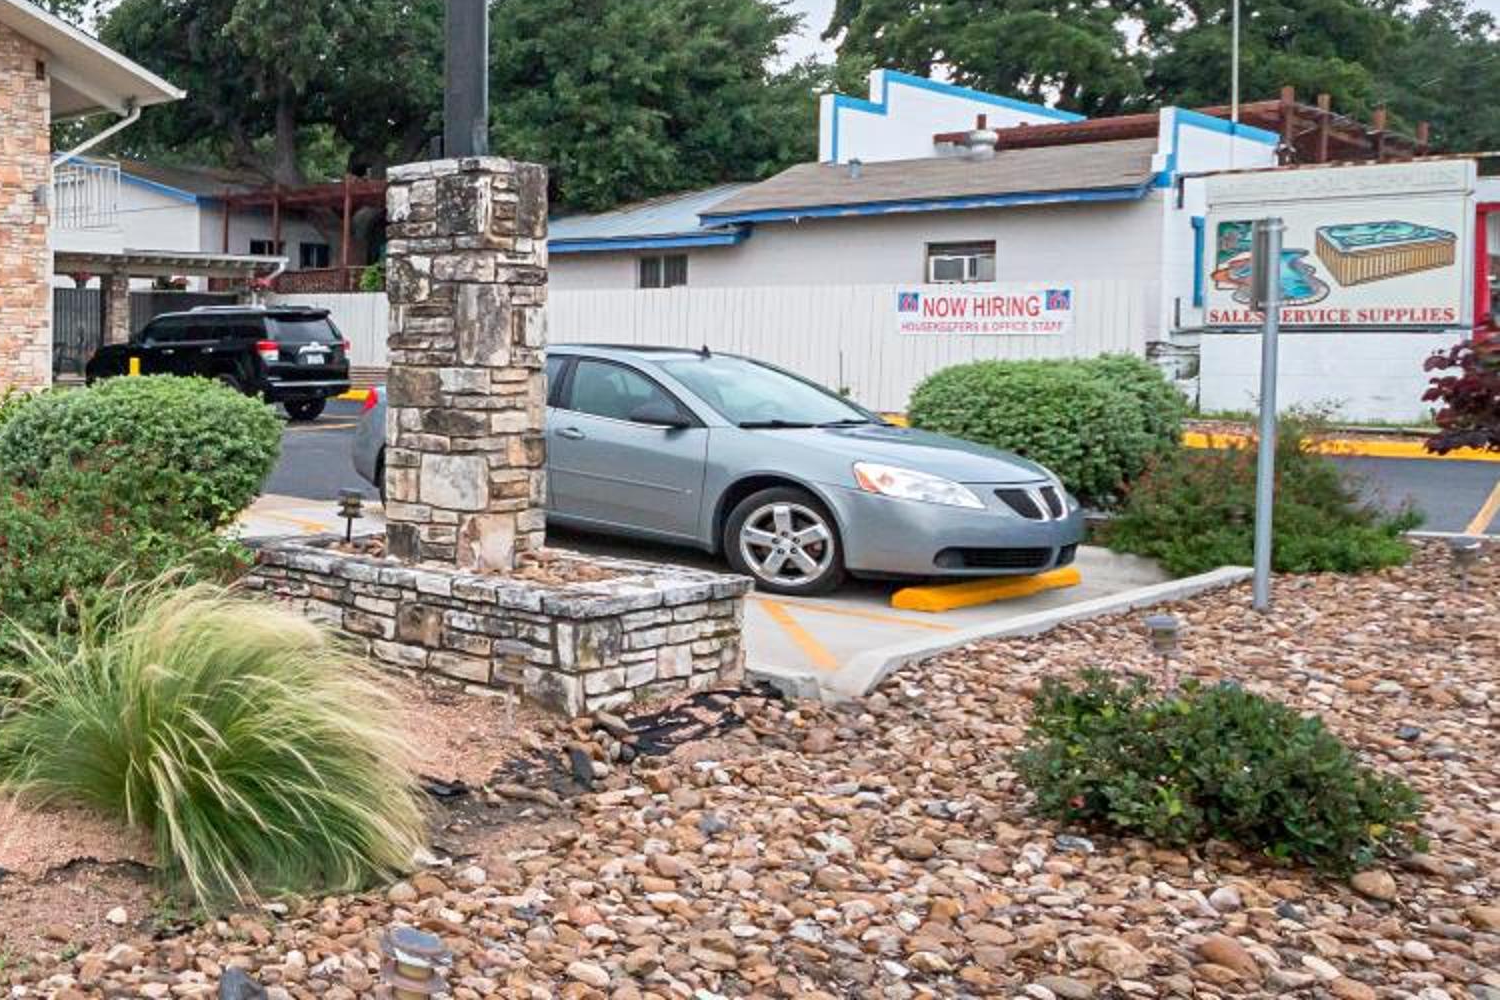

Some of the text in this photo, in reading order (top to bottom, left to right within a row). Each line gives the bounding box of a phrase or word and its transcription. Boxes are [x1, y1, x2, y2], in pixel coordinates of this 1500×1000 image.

[923, 295, 1040, 317] NOW HIRING
[1209, 307, 1455, 323] SALES ERVICE SUPPLIES
[991, 321, 1029, 331] OFFICE
[1031, 320, 1062, 331] STAFF
